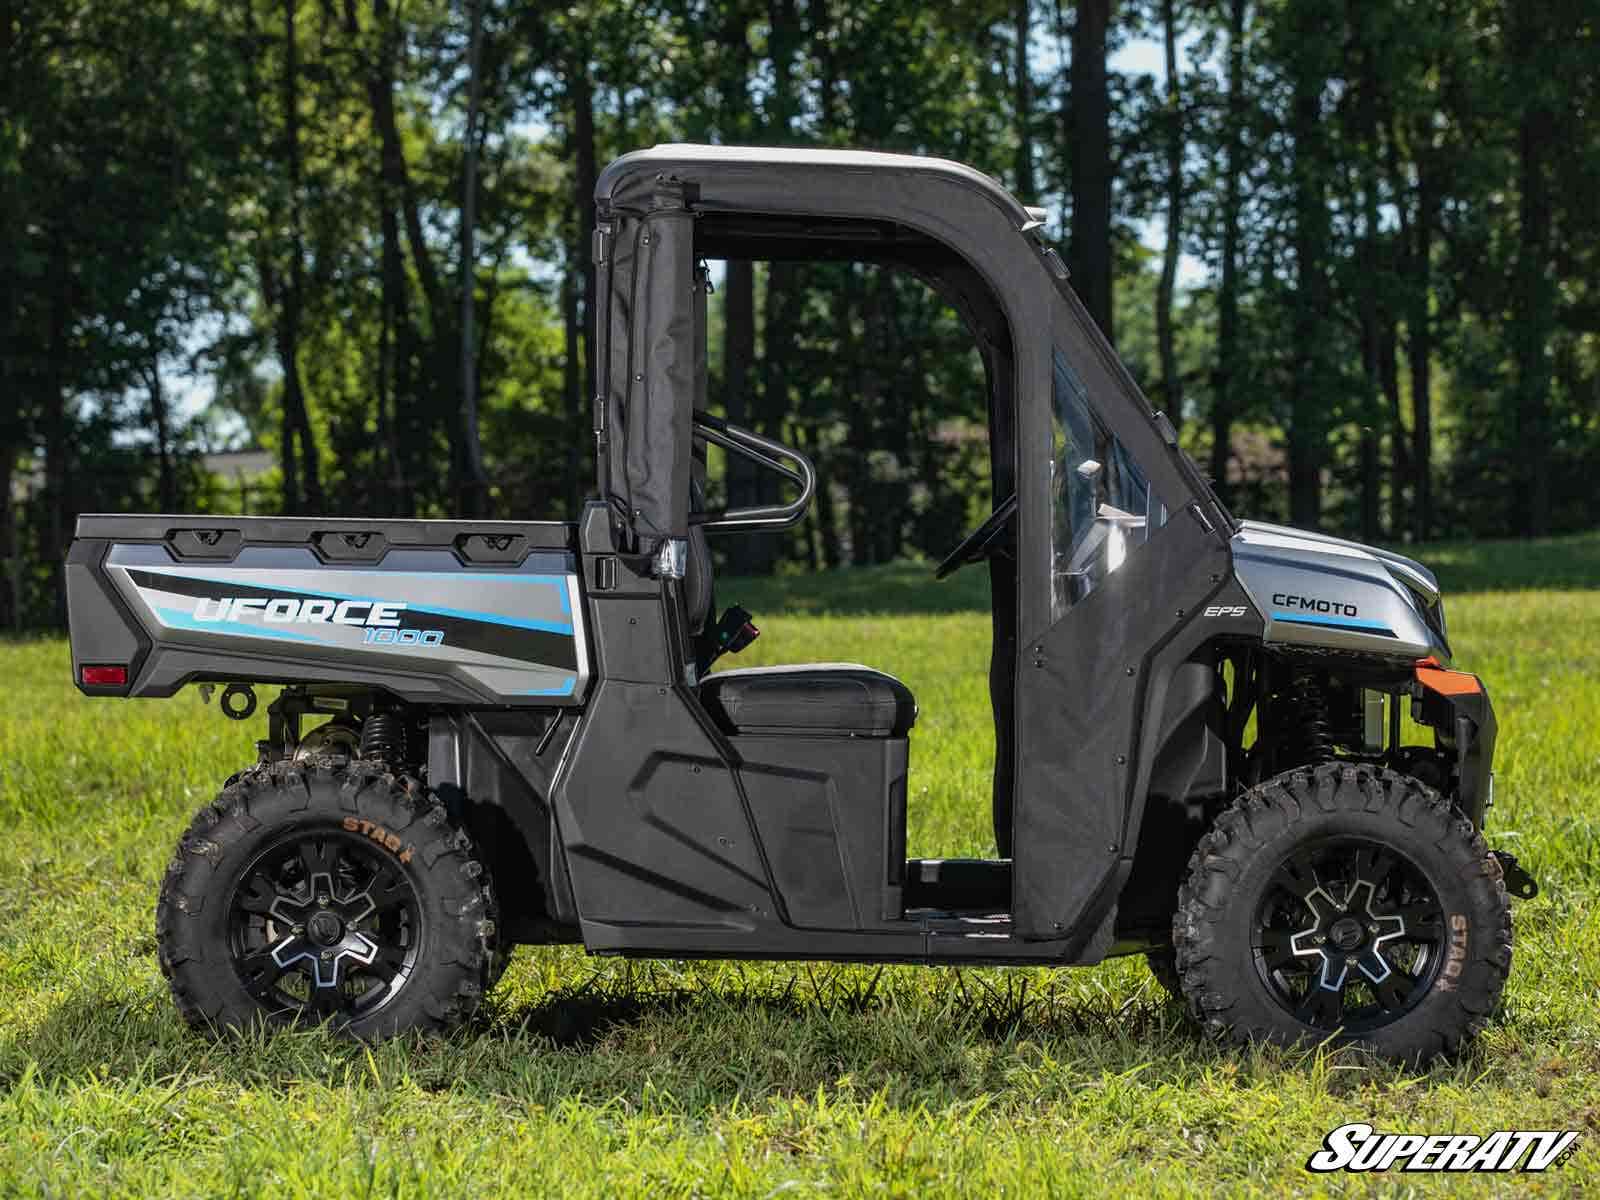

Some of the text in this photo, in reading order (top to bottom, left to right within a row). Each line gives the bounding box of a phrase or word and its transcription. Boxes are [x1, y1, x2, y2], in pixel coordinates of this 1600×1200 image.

[193, 597, 408, 627] UFORCE
[1203, 606, 1248, 617] EPS
[1272, 594, 1358, 617] CFMOTO
[363, 628, 445, 647] 1000
